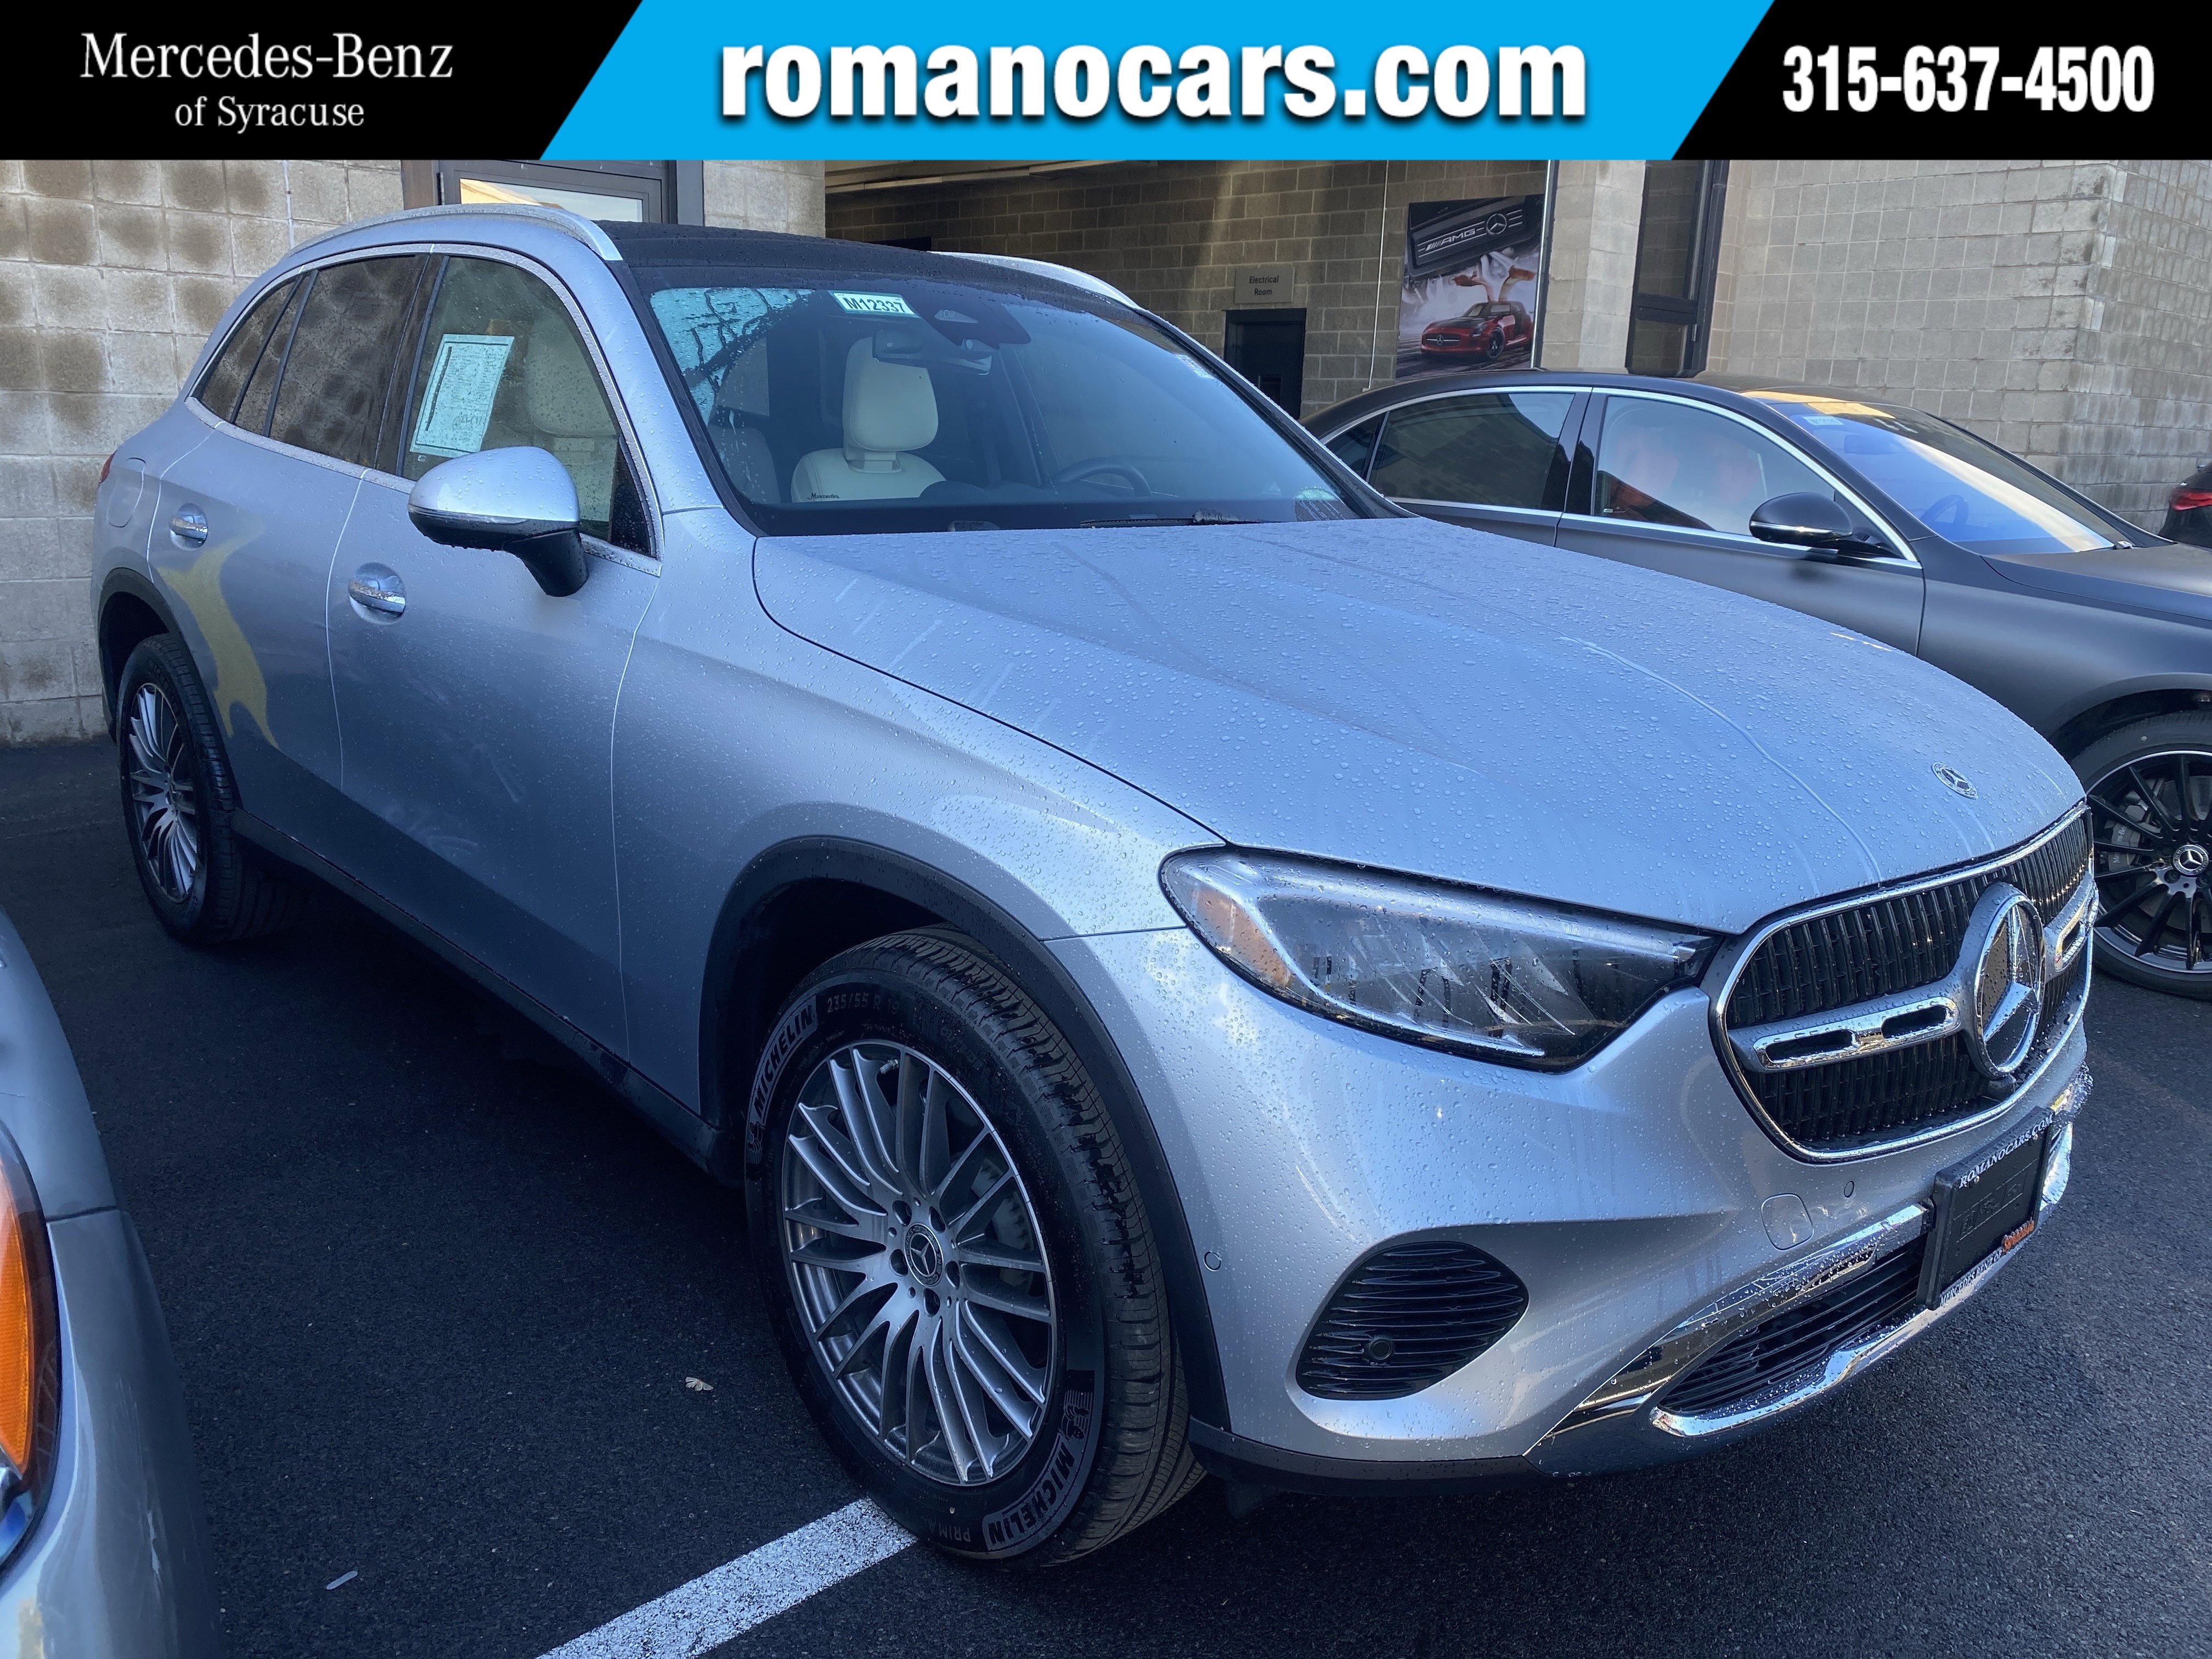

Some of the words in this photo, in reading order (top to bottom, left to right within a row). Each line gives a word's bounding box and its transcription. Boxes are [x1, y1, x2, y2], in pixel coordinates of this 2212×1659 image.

[1440, 228, 1477, 246] AMG
[1249, 275, 1279, 284] Electrical
[842, 297, 906, 313] M12337
[807, 492, 840, 500] Mercedes
[827, 991, 870, 1014] 235/55
[753, 1003, 815, 1118] MICHELIN
[1959, 1111, 2053, 1189] ROMANOCARS.COM
[988, 1442, 1076, 1546] MICHELIN
